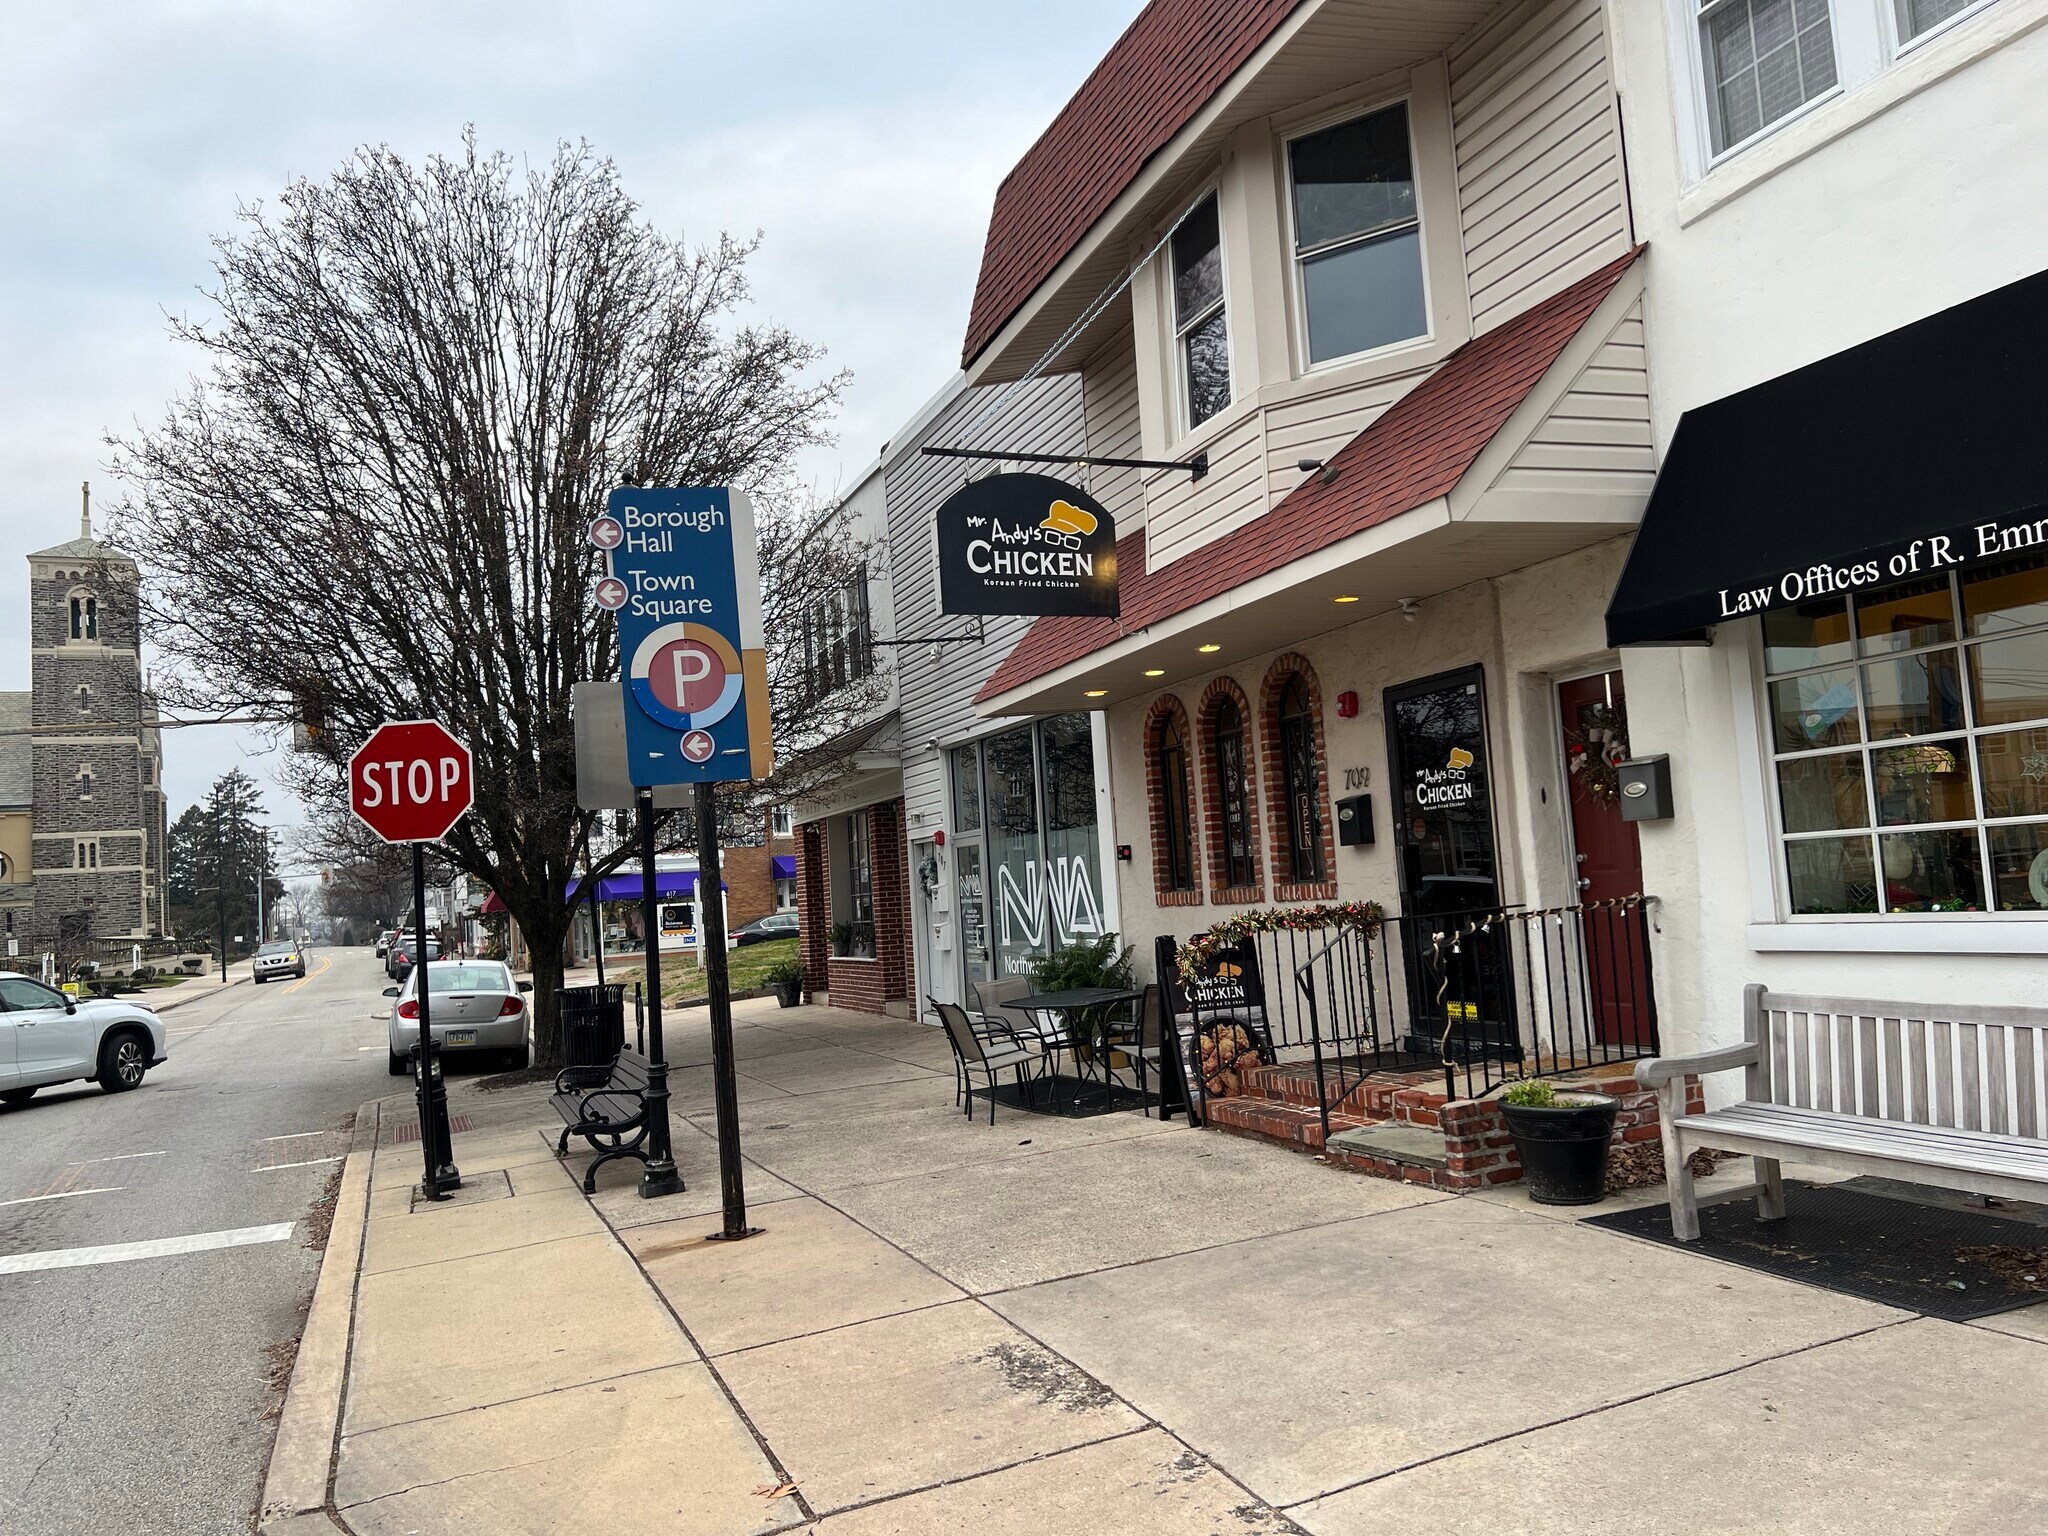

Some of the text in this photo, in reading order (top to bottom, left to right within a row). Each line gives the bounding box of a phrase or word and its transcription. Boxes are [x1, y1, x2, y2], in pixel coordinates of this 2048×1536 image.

[624, 505, 724, 532] Borough
[966, 516, 1042, 545] Mr. Andy's
[626, 531, 673, 553] Hall
[966, 539, 1094, 577] CHICKEN
[628, 570, 695, 592] Town
[984, 579, 1080, 588] Korean Fried Chicken
[1718, 586, 1774, 617] Law
[1781, 558, 1880, 601] Offices
[1889, 540, 1923, 576] of
[1928, 535, 1965, 568] R.
[631, 595, 713, 622] Square
[673, 649, 711, 708] P
[363, 757, 460, 808] STOP
[1342, 766, 1370, 791] 709
[1425, 768, 1447, 784] Andy's
[1416, 783, 1472, 804] CHICKEN
